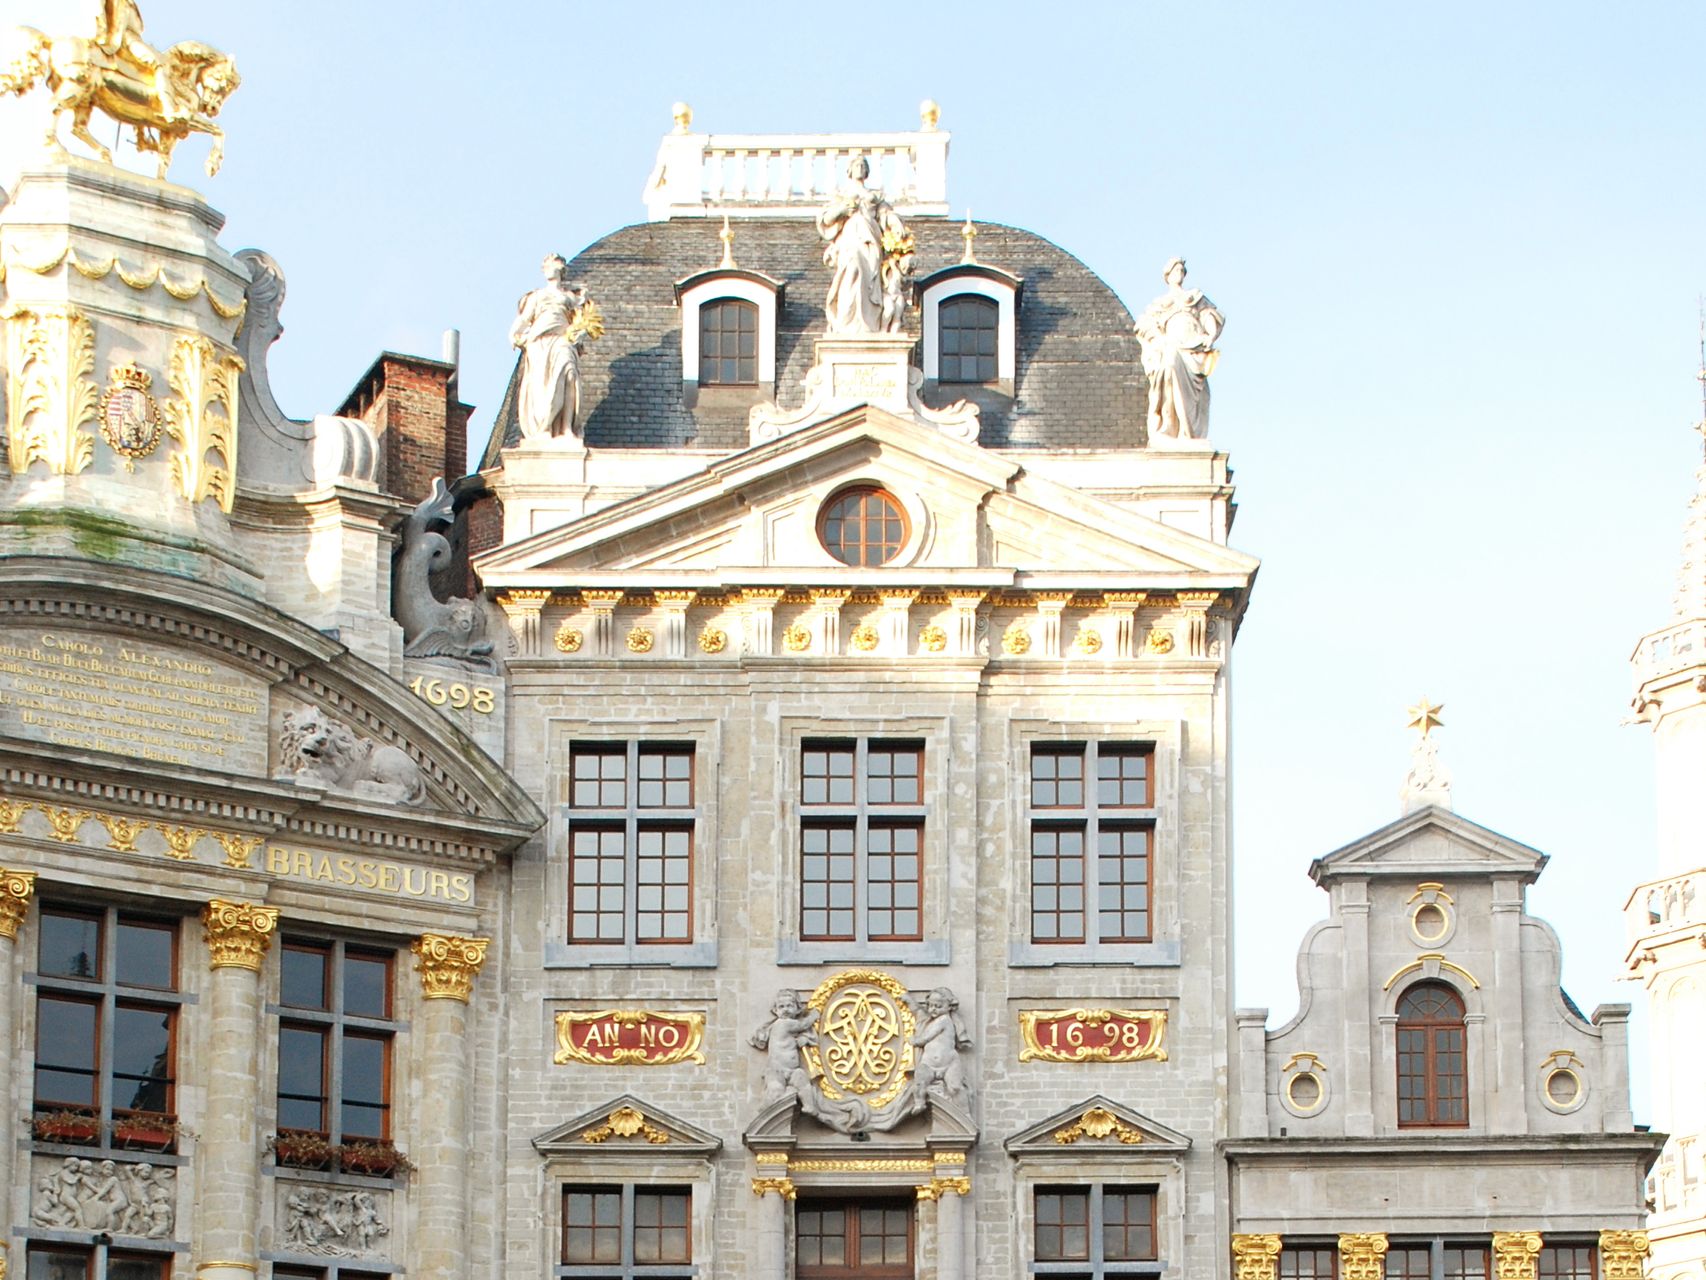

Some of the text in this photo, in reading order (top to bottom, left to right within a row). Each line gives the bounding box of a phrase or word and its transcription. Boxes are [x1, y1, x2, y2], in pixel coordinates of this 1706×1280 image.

[42, 634, 104, 656] CAROLO
[119, 648, 212, 676] ALEXANDRO
[408, 675, 495, 714] 1698
[265, 846, 472, 902] BRASSEURS
